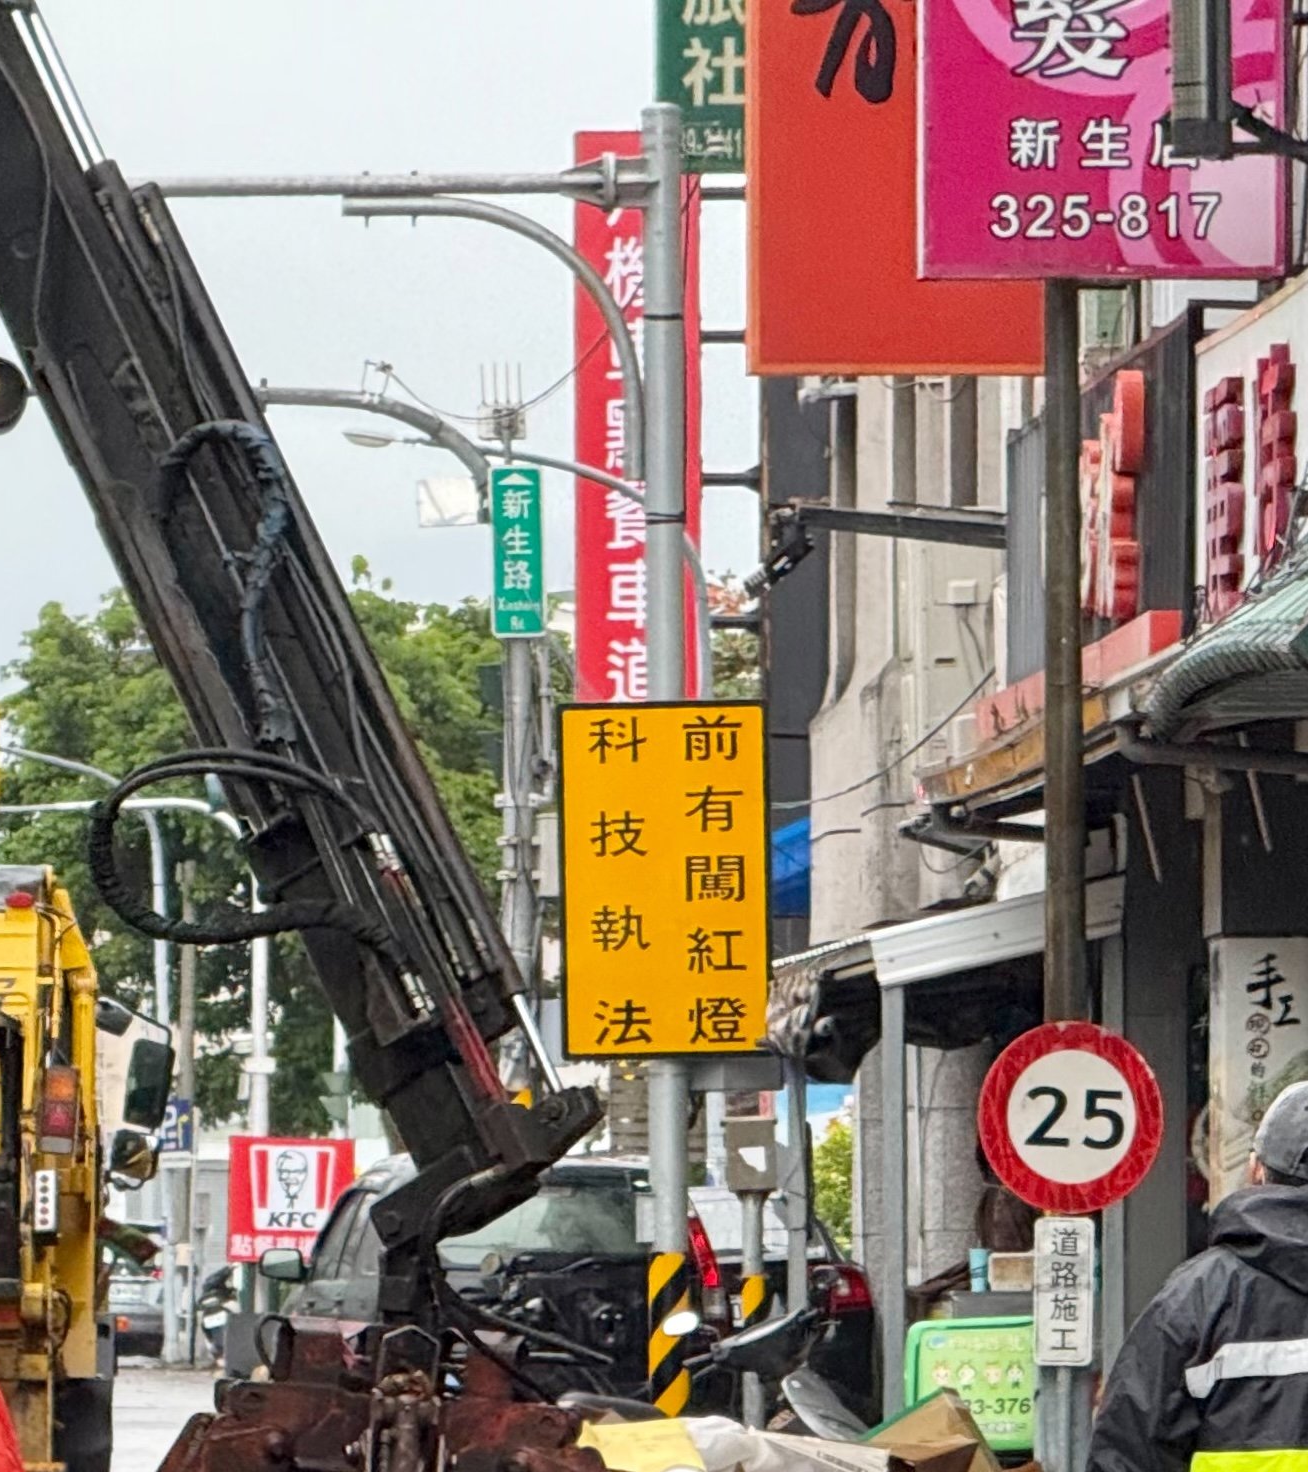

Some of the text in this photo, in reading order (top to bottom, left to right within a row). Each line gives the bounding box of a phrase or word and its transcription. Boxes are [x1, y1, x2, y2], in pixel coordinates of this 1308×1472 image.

[682, 0, 746, 107] 社
[990, 194, 1221, 239] 325-817
[502, 489, 533, 590] 新生路
[589, 716, 652, 1046] 科技執法
[682, 714, 747, 1045] 前有闖紅燈
[1025, 1086, 1125, 1150] 25
[267, 1212, 317, 1228] KFC
[1050, 1228, 1081, 1352] 道路施工
